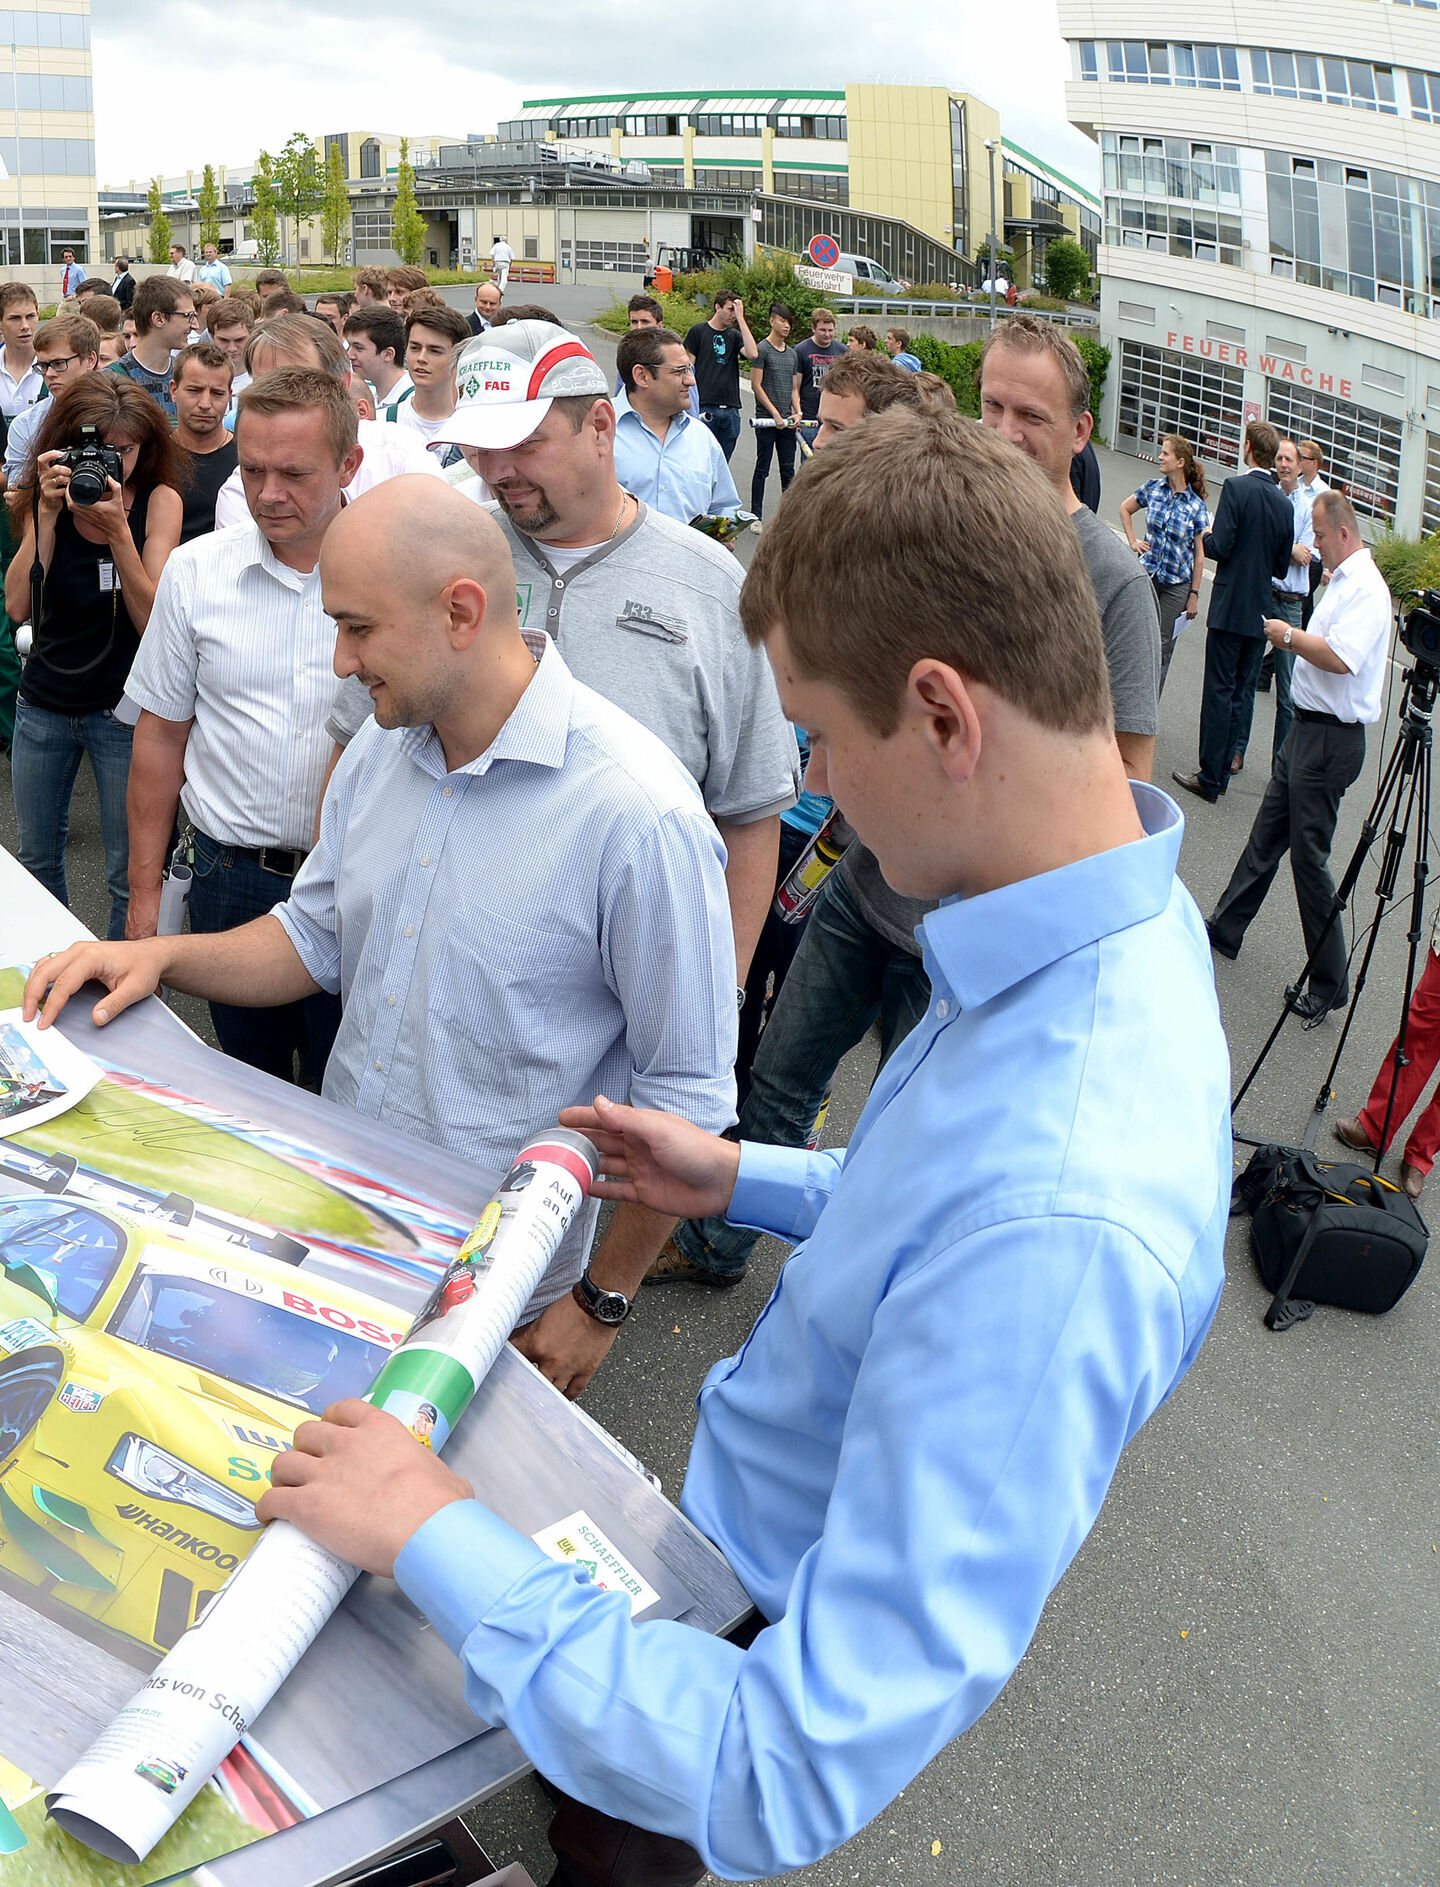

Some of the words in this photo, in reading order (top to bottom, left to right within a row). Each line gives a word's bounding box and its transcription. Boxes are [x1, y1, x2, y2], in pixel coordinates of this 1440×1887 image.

[798, 266, 845, 282] Feuerwehr
[459, 360, 511, 377] CHAEFFLER
[484, 381, 510, 391] FAG
[577, 1525, 643, 1596] SCHAEFFLER
[171, 1679, 207, 1701] von
